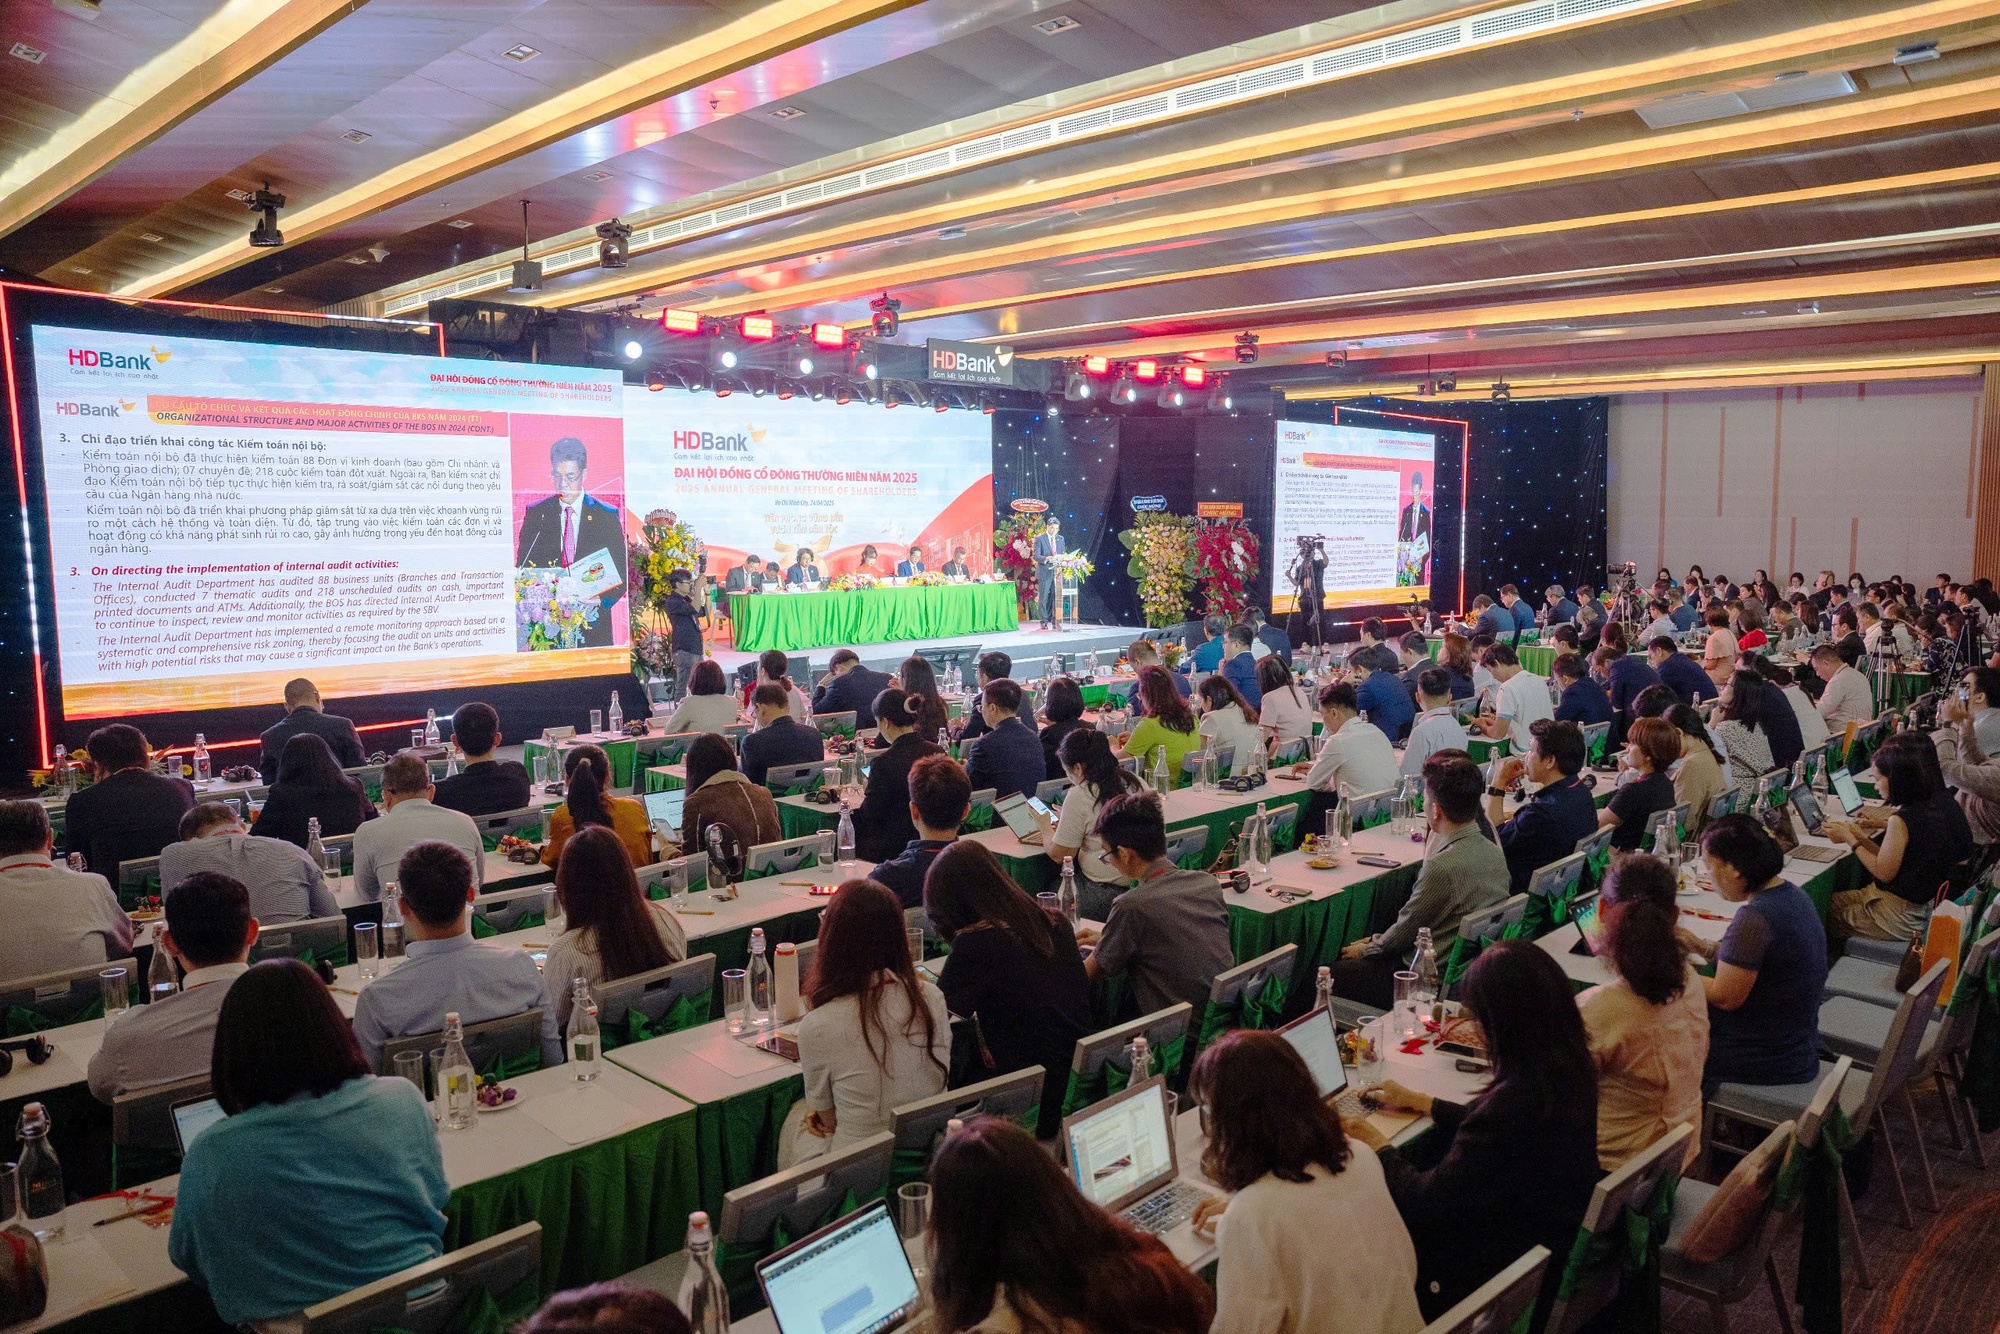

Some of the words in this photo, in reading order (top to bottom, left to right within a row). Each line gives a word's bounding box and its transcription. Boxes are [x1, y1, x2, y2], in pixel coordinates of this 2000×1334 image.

[68, 348, 151, 371] HDBank
[933, 350, 996, 373] HDBank
[430, 374, 444, 383] ĐẠI
[56, 402, 120, 417] HDBank
[157, 412, 241, 423] ORGANIZATIONAL
[243, 415, 293, 425] STRUCTURE
[295, 418, 315, 426] AND
[317, 419, 346, 427] MAJOR
[348, 420, 391, 429] ACTIVITIES
[404, 422, 419, 430] THE
[448, 424, 466, 432] 2024
[467, 425, 494, 433] (CONT.)
[59, 434, 70, 443] 3.
[104, 435, 127, 447] đạo
[160, 437, 184, 446] khai
[187, 437, 215, 449] công
[217, 438, 234, 447] tác
[266, 440, 288, 449] toán
[291, 441, 308, 452] nội
[310, 441, 326, 452] bộ:
[673, 430, 748, 452] HDBank
[674, 467, 695, 481] ĐẠI
[697, 466, 717, 481] HỘI
[769, 468, 800, 480] ĐÔNG
[845, 470, 868, 482] NIÊN
[893, 472, 918, 483] 2025
[70, 566, 81, 575] 3.
[91, 566, 109, 575] On
[112, 564, 164, 577] directing
[166, 564, 184, 573] the
[187, 562, 271, 575] implementation
[273, 562, 284, 570] of
[286, 561, 325, 570] internal
[327, 560, 353, 569] audit
[354, 559, 399, 568] activities:
[94, 582, 113, 592] The
[118, 581, 160, 591] Internal
[163, 580, 192, 589] Audit
[196, 578, 255, 591] Department
[259, 577, 276, 586] has
[279, 576, 314, 585] audited
[318, 576, 330, 584] 88
[333, 574, 370, 583] business
[373, 573, 394, 582] units
[441, 571, 457, 579] and
[460, 570, 504, 579] Transaction
[93, 594, 138, 606] Offices),
[143, 592, 196, 602] conducted
[202, 592, 208, 600] 7
[213, 590, 256, 600] thematic
[261, 588, 290, 598] audits
[294, 588, 313, 596] and
[318, 587, 335, 595] 218
[339, 585, 393, 595] unscheduled
[397, 584, 422, 592] audits
[441, 582, 461, 592] cash,
[466, 580, 504, 592] important
[94, 607, 133, 620] printed
[136, 604, 193, 615] documents
[195, 603, 215, 612] and
[217, 602, 246, 611] ATMs.
[248, 599, 306, 612] Additionally,
[309, 599, 324, 607] the
[326, 598, 345, 606] BOS
[347, 597, 362, 605] has
[365, 595, 398, 605] directed
[434, 593, 456, 601] Audit
[458, 591, 505, 602] Department
[95, 621, 107, 629] to
[109, 618, 156, 629] continue
[158, 618, 169, 626] to
[172, 615, 210, 628] inspect,
[212, 614, 244, 624] review
[246, 613, 264, 622] and
[266, 611, 304, 621] monitor
[305, 609, 344, 619] activities
[358, 607, 394, 618] required
[396, 606, 406, 616] by
[407, 605, 421, 614] the
[98, 636, 117, 646] The
[120, 634, 162, 645] Internal
[163, 632, 191, 642] Audit
[194, 629, 253, 643] Department
[255, 628, 272, 637] has
[274, 624, 334, 638] implemented
[344, 623, 374, 632] remote
[377, 619, 423, 632] monitoring
[424, 617, 462, 629] approach
[464, 616, 486, 624] based
[97, 646, 154, 661] systematic
[156, 645, 176, 655] and
[178, 640, 252, 656] comprehensive
[254, 639, 270, 648] risk
[273, 637, 306, 650] zoning,
[308, 635, 342, 647] thereby
[344, 633, 380, 645] focusing
[382, 632, 396, 640] the
[398, 630, 419, 639] audit
[434, 628, 454, 637] units
[455, 627, 471, 636] and
[472, 625, 506, 635] activities
[98, 661, 122, 671] with
[125, 659, 149, 672] high
[151, 656, 198, 670] potential
[200, 654, 222, 664] risks
[224, 653, 244, 662] that
[246, 654, 267, 663] may
[306, 646, 351, 659] significant
[353, 644, 383, 656] impact
[398, 642, 411, 650] the
[413, 640, 439, 649] Bank's
[441, 638, 484, 650] operations.
